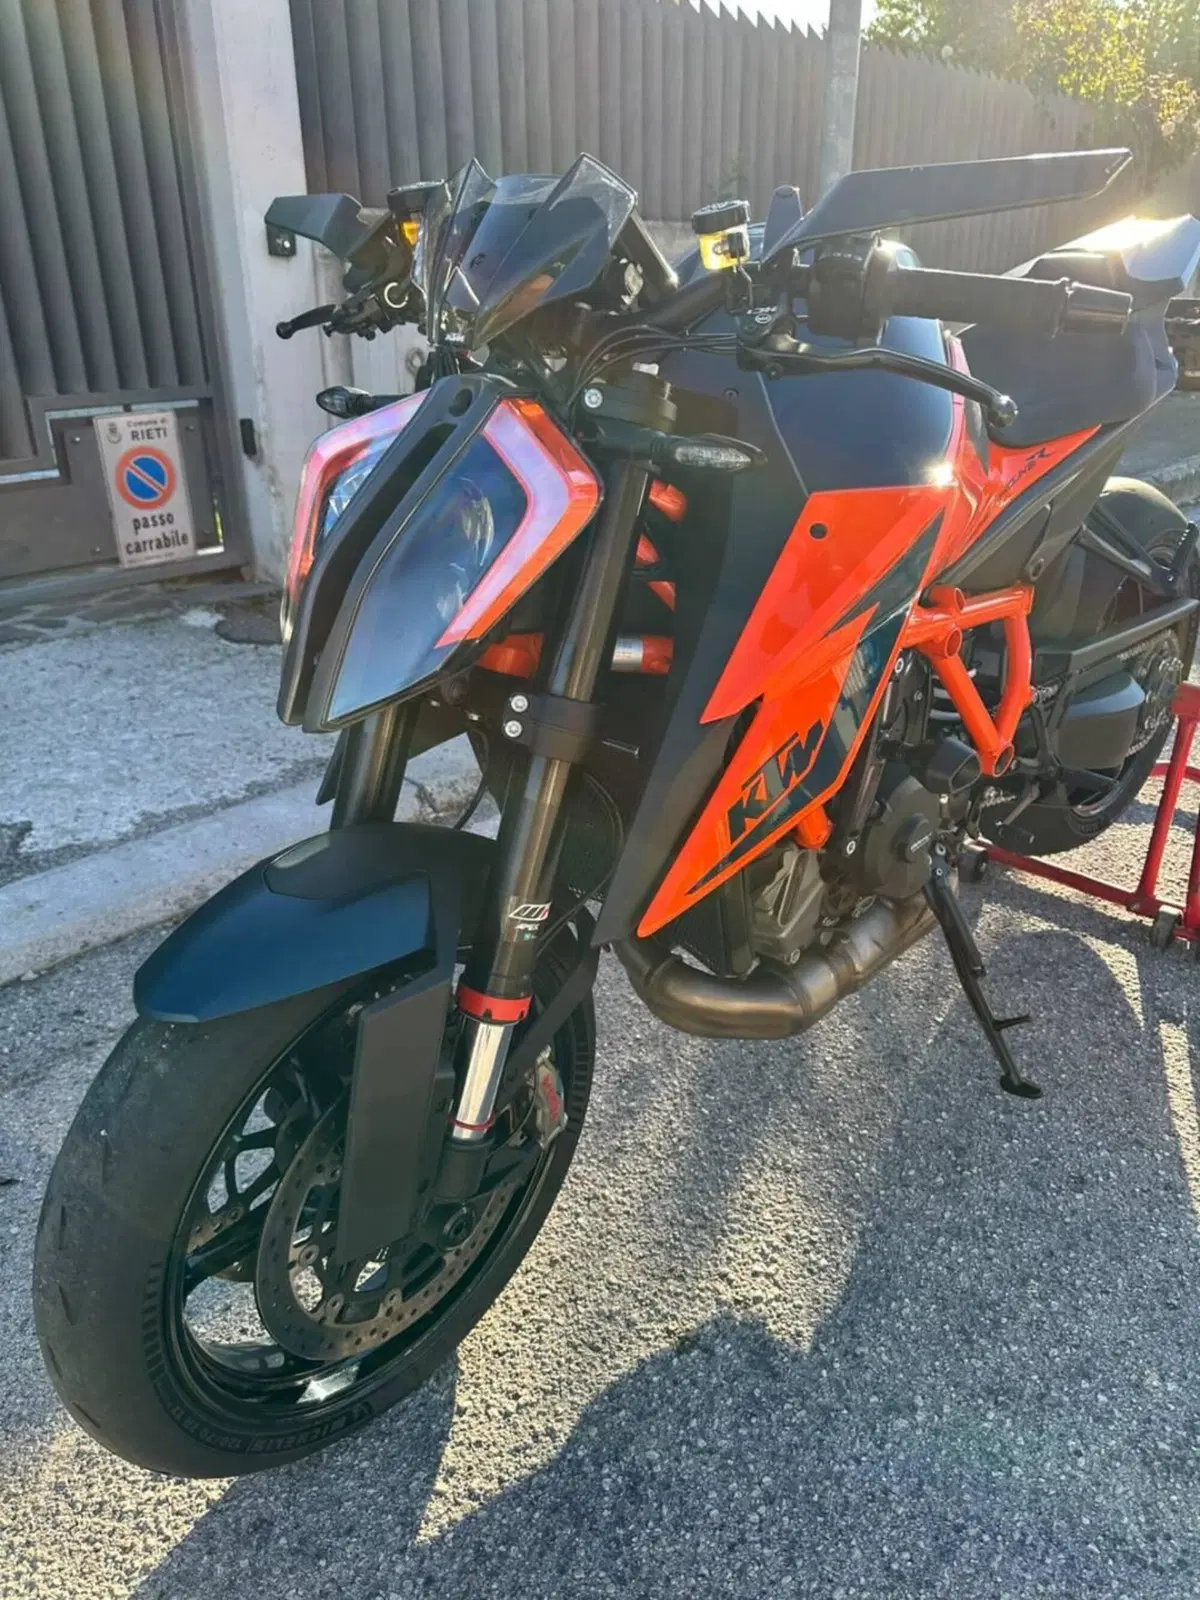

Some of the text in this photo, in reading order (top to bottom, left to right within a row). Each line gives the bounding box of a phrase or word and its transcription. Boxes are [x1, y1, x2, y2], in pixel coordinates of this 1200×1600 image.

[131, 427, 168, 441] RIETI
[132, 512, 175, 534] passo
[125, 530, 189, 555] carrabile
[726, 718, 824, 846] KTM
